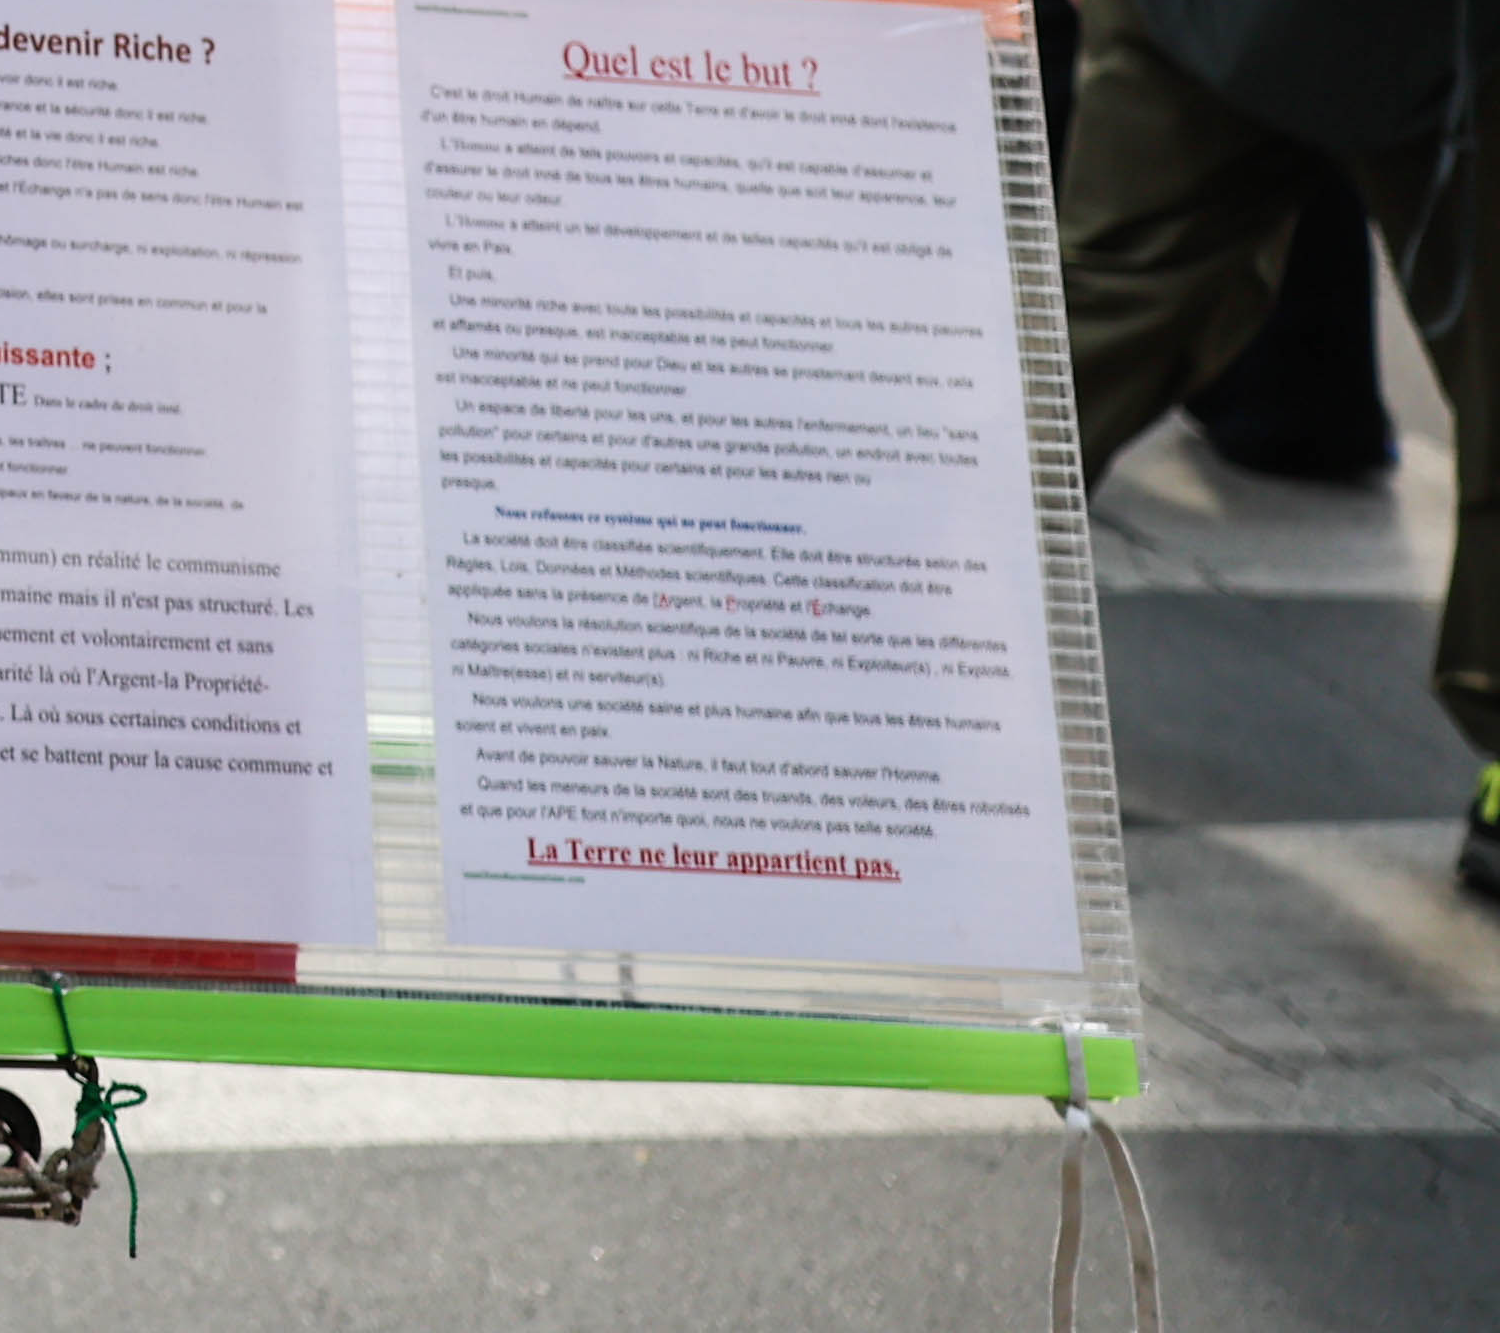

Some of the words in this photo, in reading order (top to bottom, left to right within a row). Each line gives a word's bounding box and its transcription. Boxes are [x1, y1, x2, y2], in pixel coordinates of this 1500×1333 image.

[113, 32, 192, 64] Riche
[562, 41, 639, 80] Quel
[649, 54, 693, 83] est
[704, 49, 731, 86] le
[741, 52, 792, 90] but
[60, 552, 83, 568] en
[87, 550, 141, 571] réalité
[146, 551, 162, 573] le
[166, 558, 281, 579] communisme
[57, 590, 99, 607] mais
[103, 589, 117, 609] il
[120, 591, 160, 611] n'est
[164, 596, 194, 616] pas
[198, 596, 278, 617] structuré.
[283, 597, 315, 618] Les
[59, 630, 76, 646] et
[81, 628, 211, 653] volontairement
[215, 638, 232, 654] et
[236, 640, 275, 655] sans
[527, 836, 559, 862] La
[565, 838, 632, 865] Terre
[639, 847, 666, 867] ne
[672, 843, 719, 869] leur
[726, 849, 847, 877] appartient
[854, 857, 900, 877] pas.
